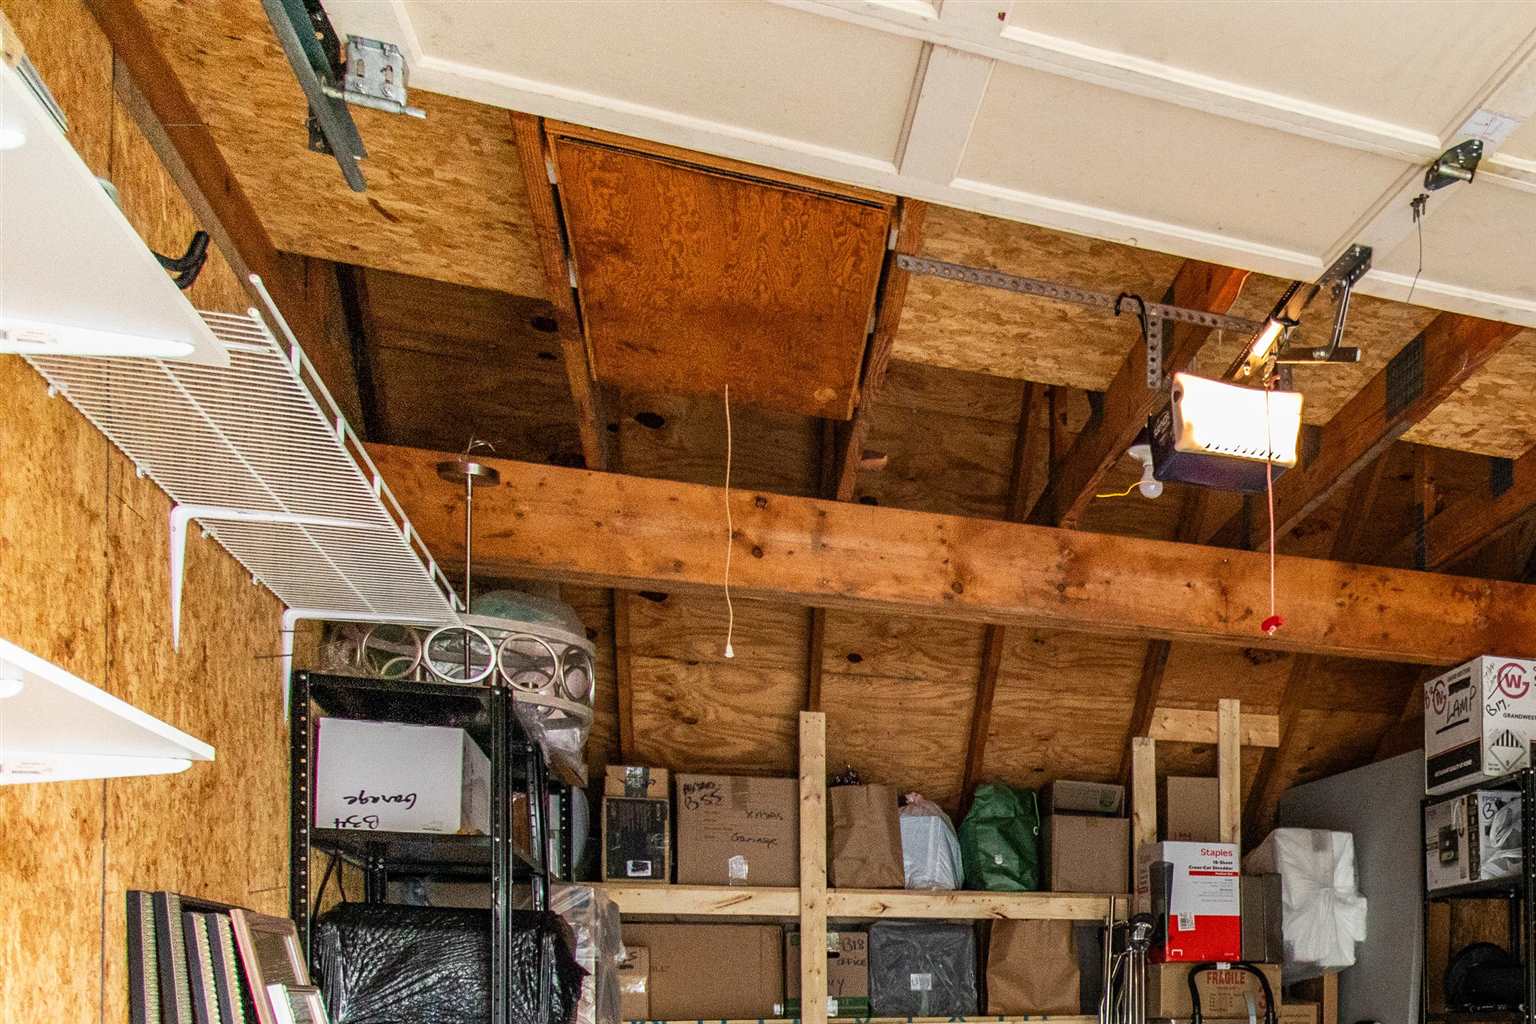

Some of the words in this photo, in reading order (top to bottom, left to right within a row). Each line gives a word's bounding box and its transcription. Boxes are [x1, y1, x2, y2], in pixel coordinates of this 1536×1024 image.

[1446, 685, 1477, 724] LAMP
[1200, 847, 1233, 858] Staples
[1206, 971, 1247, 984] FRAGILE
